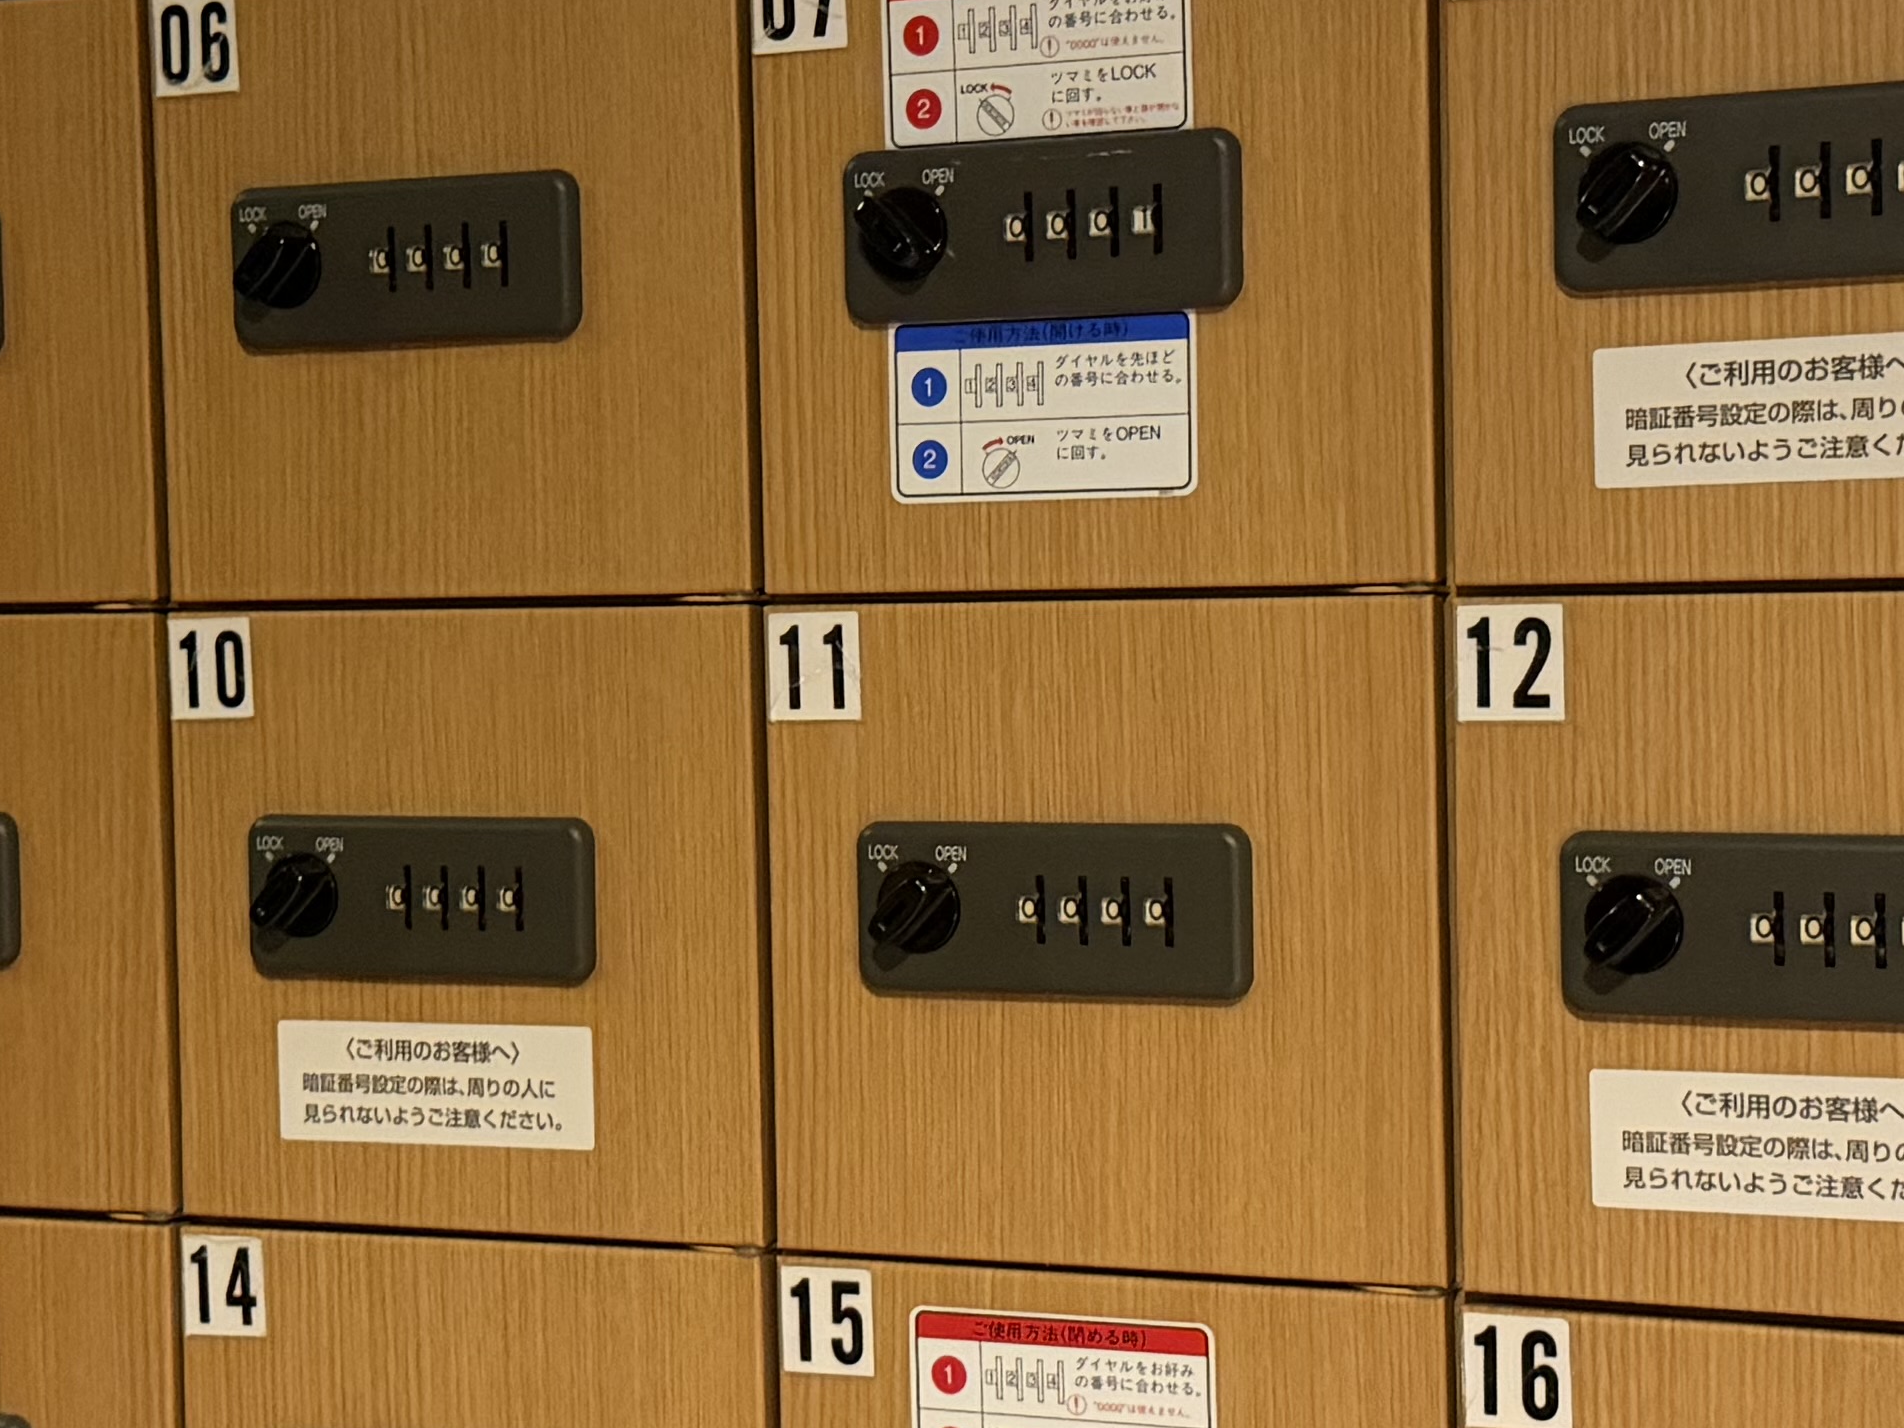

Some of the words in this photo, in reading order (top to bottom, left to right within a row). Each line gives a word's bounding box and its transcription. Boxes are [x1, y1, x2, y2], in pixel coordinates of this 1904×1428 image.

[1048, 7, 1176, 29] の番号に合わせる。
[160, 1, 230, 83] 06
[1051, 63, 1156, 83] ツマミをLOCK
[961, 83, 988, 94] LOCK
[1051, 87, 1102, 104] に回す。
[1569, 125, 1605, 144] LOCK
[1649, 121, 1687, 140] OPEN
[854, 173, 885, 189] LOCK
[922, 169, 954, 185] OPEN
[239, 207, 266, 222] LOCK
[299, 204, 326, 220] OPEN
[1055, 349, 1175, 369] ダイヤルを先ほど
[1055, 370, 1182, 387] の番号に合わせる。
[1007, 434, 1034, 445] OPEN
[1056, 426, 1161, 443] ツマミをOPEN
[1056, 445, 1106, 460] に回す。
[179, 630, 245, 709] 10
[779, 624, 845, 710] 11
[1467, 616, 1552, 709] 12
[256, 835, 283, 851] LOCK
[316, 837, 343, 853] OPEN
[868, 845, 898, 860] LOCK
[935, 845, 967, 862] OPEN
[1575, 856, 1611, 873] LOCK
[1655, 857, 1692, 875] OPEN
[303, 1073, 556, 1100] 暗証番号設定の際は、周りの人に
[304, 1104, 564, 1133] 見られないようご注意ください。
[190, 1245, 257, 1325] 14
[791, 1278, 864, 1365] 15
[973, 1320, 1147, 1348] ご使用方法(閉める時)
[1075, 1356, 1194, 1377] ダイヤルをお好み
[1474, 1324, 1560, 1421] 16
[1075, 1375, 1201, 1397] の番号に合わせる。
